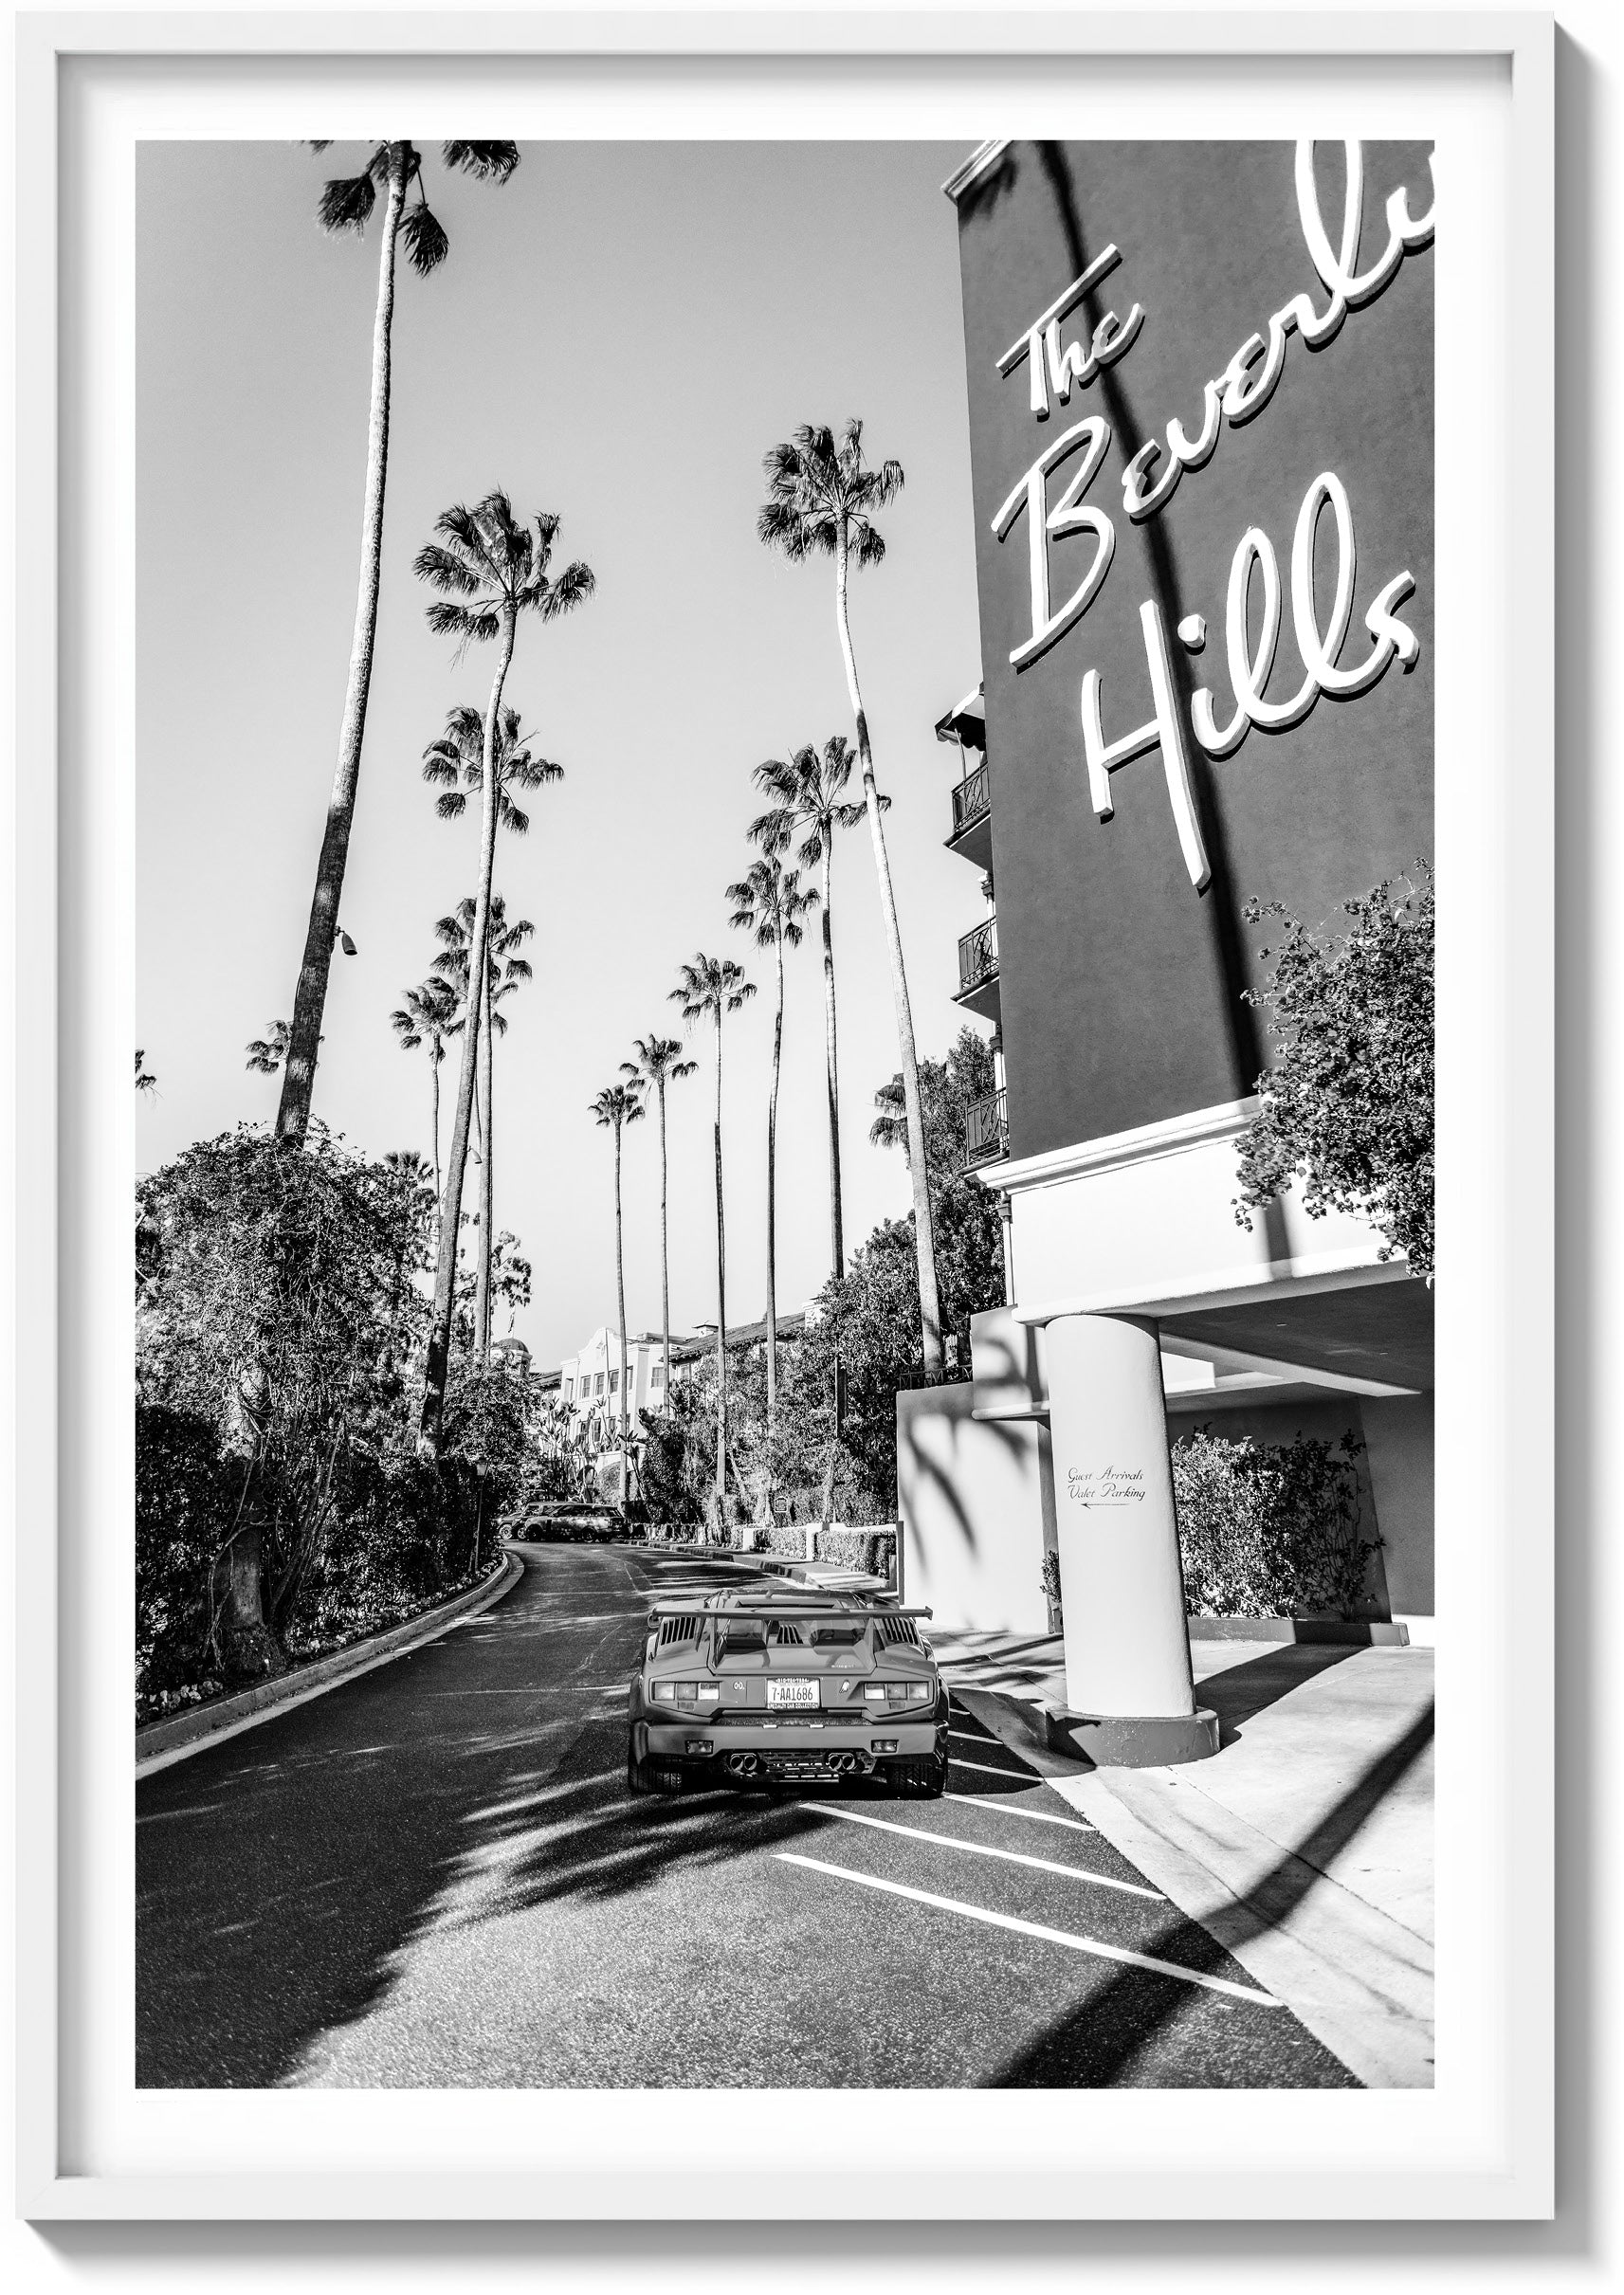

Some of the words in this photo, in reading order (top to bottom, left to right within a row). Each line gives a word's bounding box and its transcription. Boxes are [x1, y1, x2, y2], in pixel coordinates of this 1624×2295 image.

[994, 243, 1145, 416] The
[1081, 471, 1419, 890] Hills
[1067, 1466, 1093, 1484] Guest
[1096, 1465, 1144, 1481] Arrivals
[1067, 1484, 1095, 1500] Valet
[1100, 1482, 1146, 1502] Parking
